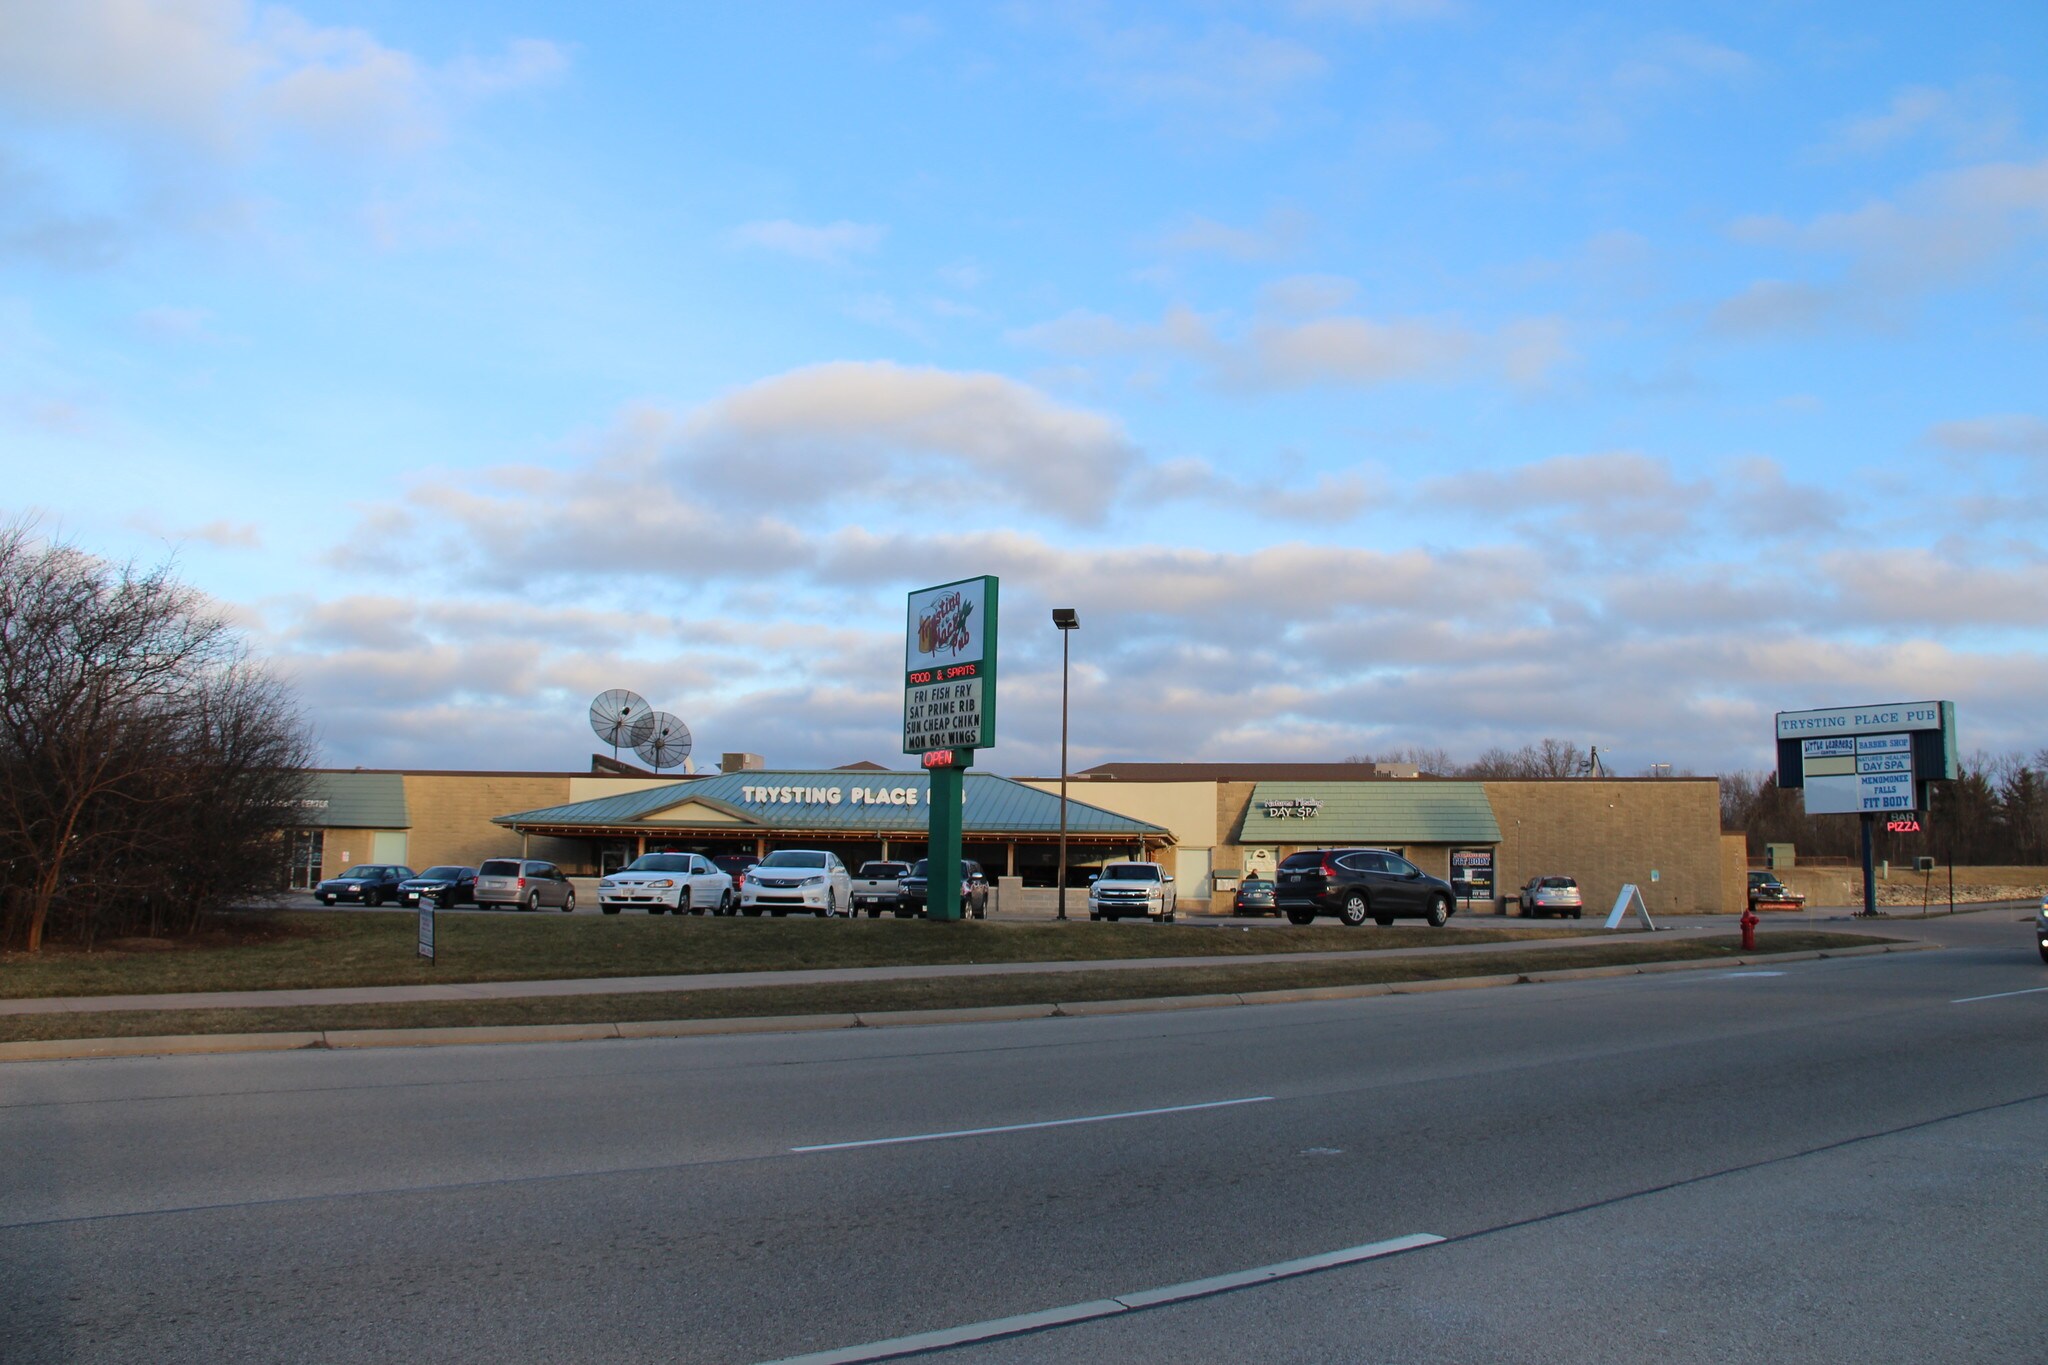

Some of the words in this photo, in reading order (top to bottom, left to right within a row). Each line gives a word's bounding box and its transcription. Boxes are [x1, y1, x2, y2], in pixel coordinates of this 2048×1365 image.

[910, 672, 931, 683] FOOD
[937, 670, 944, 680] &
[947, 665, 975, 678] SPIRITS
[914, 691, 927, 703] FRI
[931, 686, 951, 700] FISH
[955, 684, 972, 698] FRY
[910, 705, 924, 719] SAT
[928, 702, 955, 716] PRIME
[959, 699, 976, 712] RIB
[906, 721, 922, 734] SUN
[923, 717, 950, 731] CHEAP
[952, 714, 980, 728] CHIKN
[1781, 717, 1845, 729] TRYSTING
[1855, 713, 1898, 725] PLACE
[1906, 710, 1935, 721] PUB
[908, 735, 926, 749] MON
[929, 732, 946, 747] 60¢
[948, 731, 976, 744] WINGS
[1859, 740, 1887, 749] BARBER
[1889, 739, 1908, 747] SHOP
[924, 750, 952, 767] OPEN
[1885, 753, 1911, 761] HEALING
[1863, 762, 1882, 771] DAY
[1884, 761, 1903, 769] SPA
[1861, 775, 1908, 784] MENOMONEE
[742, 786, 842, 804] TRYSTING
[851, 787, 918, 805] PLACE
[1874, 786, 1897, 794] FALLS
[1863, 798, 1880, 809] FIT
[1883, 796, 1909, 807] BODY
[1270, 807, 1292, 817] DAY
[1296, 807, 1319, 817] SPA
[1891, 812, 1914, 821] BAR
[1887, 821, 1920, 832] PIZZA
[1452, 857, 1468, 866] FIT
[1469, 857, 1491, 866] BODY
